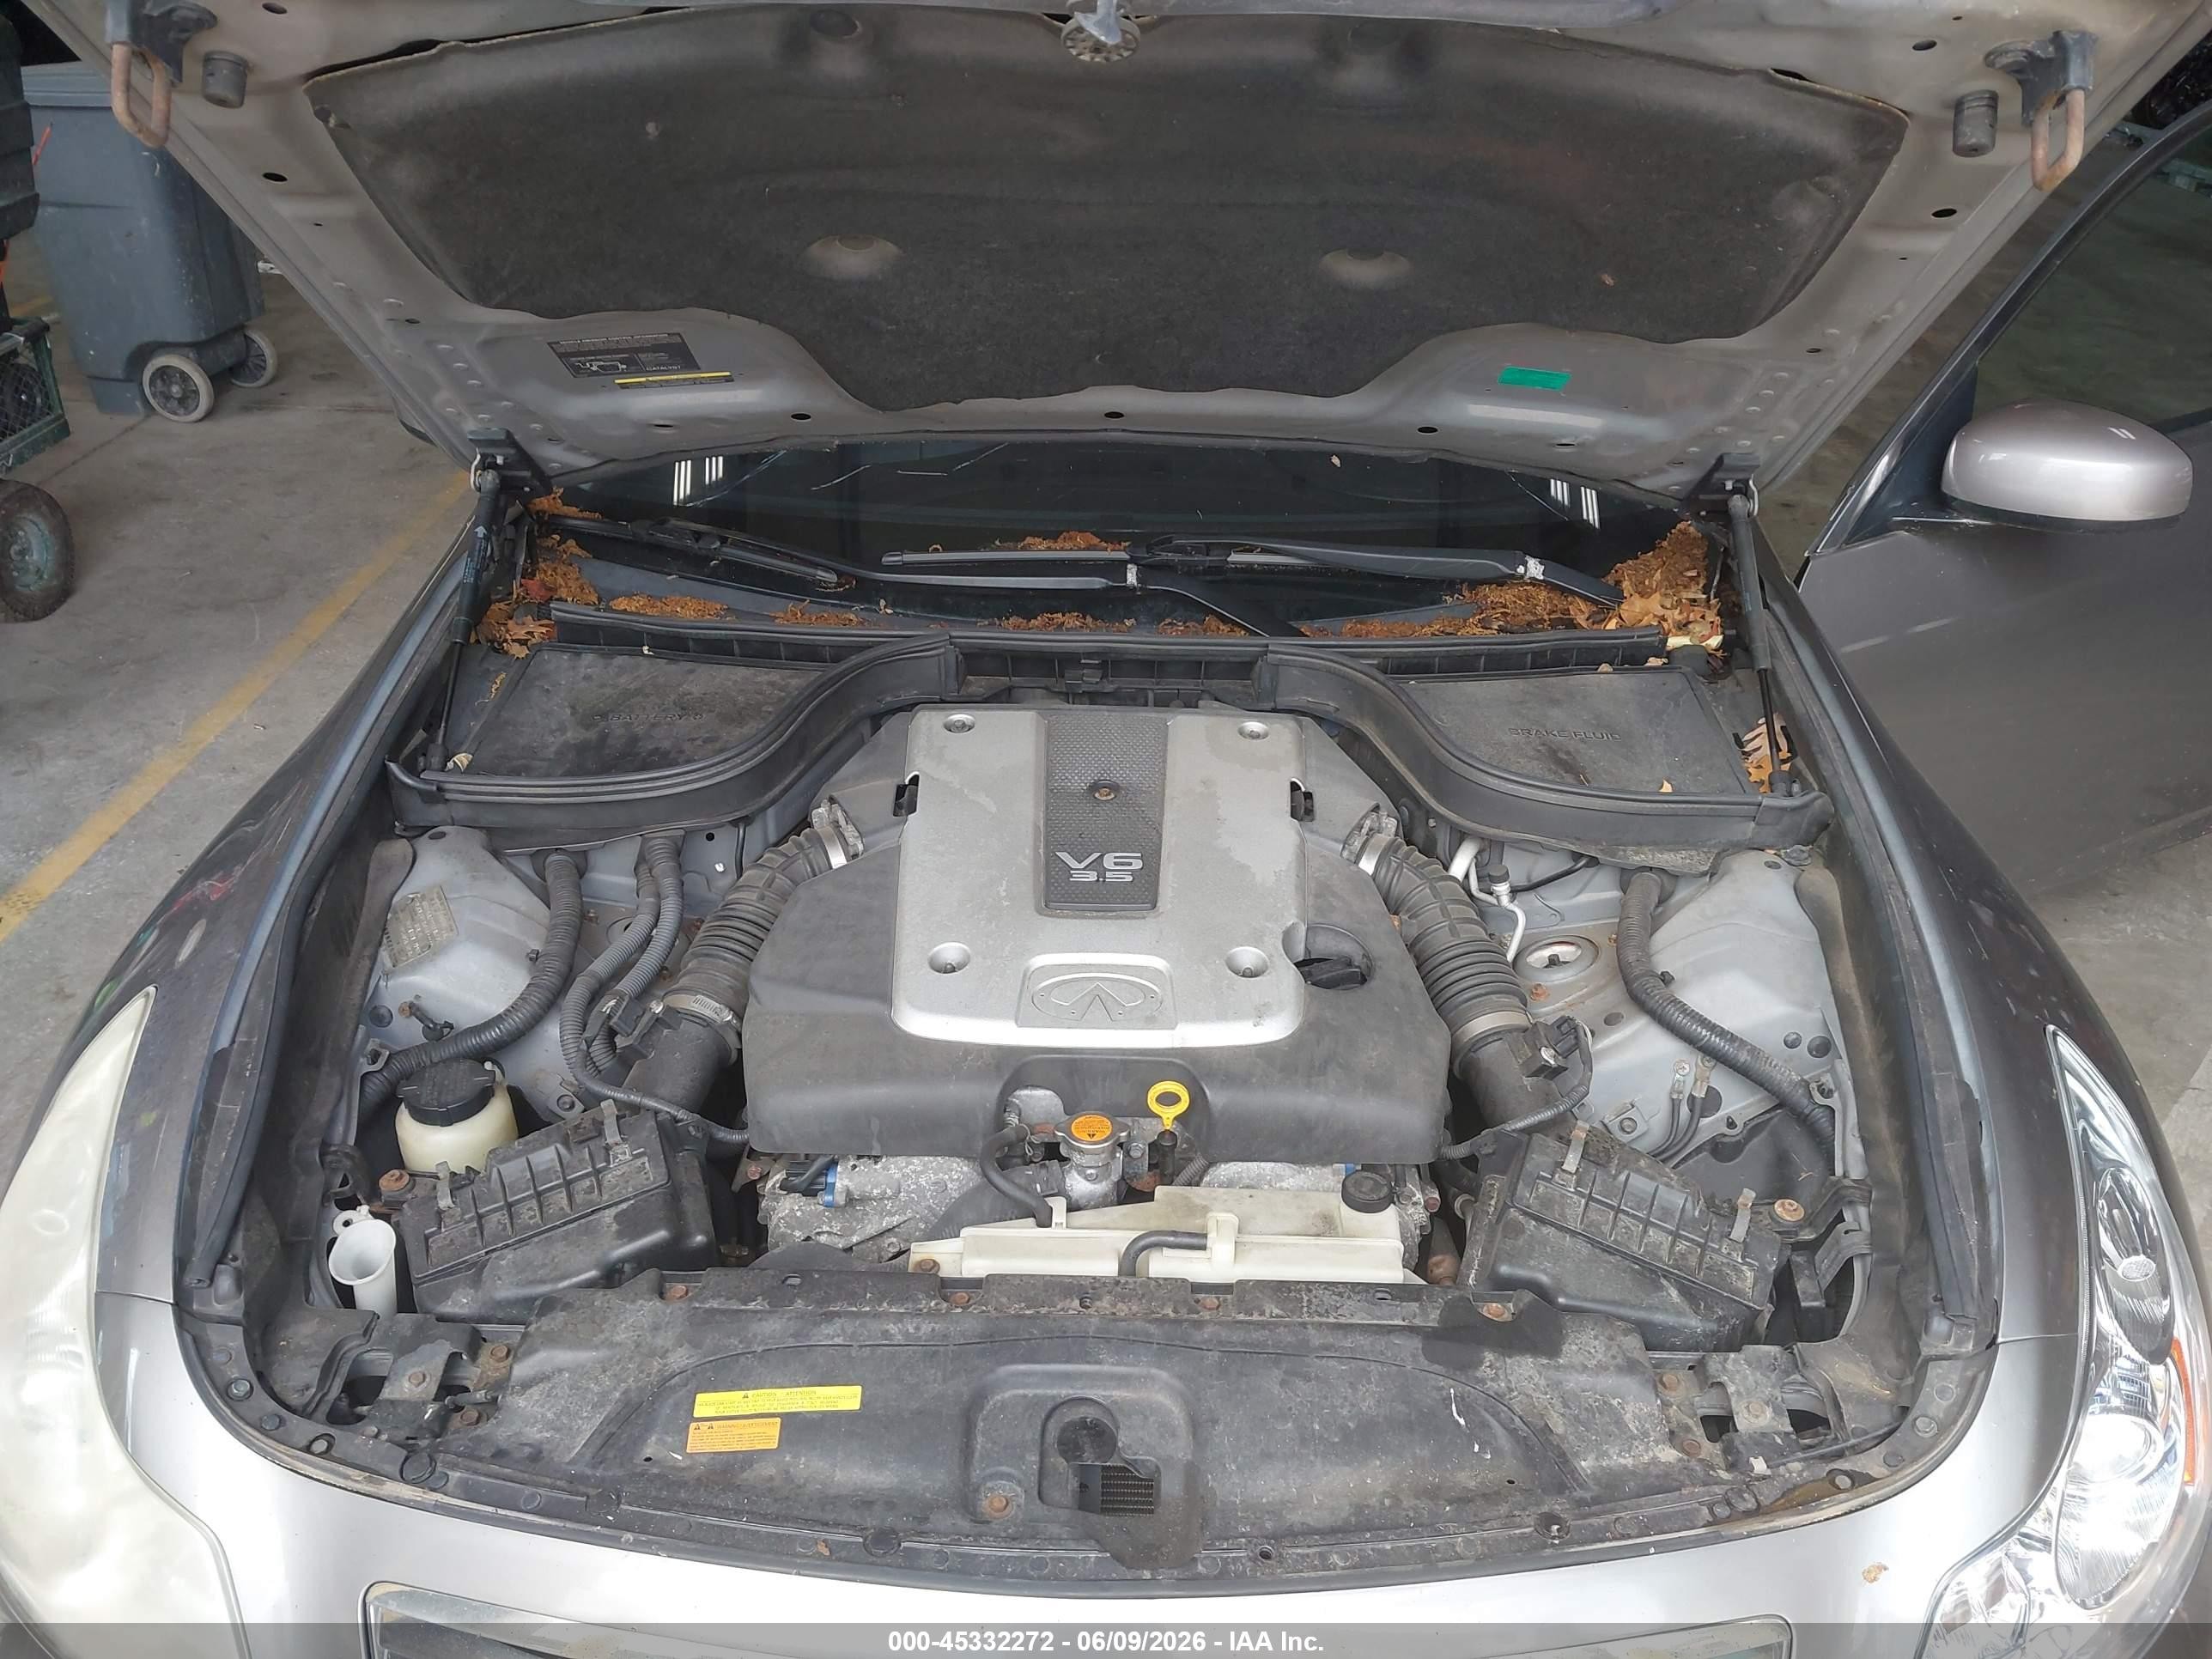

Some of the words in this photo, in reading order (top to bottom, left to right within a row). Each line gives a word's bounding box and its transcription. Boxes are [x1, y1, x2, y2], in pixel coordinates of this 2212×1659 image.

[1509, 728, 1568, 738] BRAKE
[1572, 731, 1622, 741] FLUID
[1054, 851, 1144, 870] V6
[1069, 870, 1133, 882] 3.5
